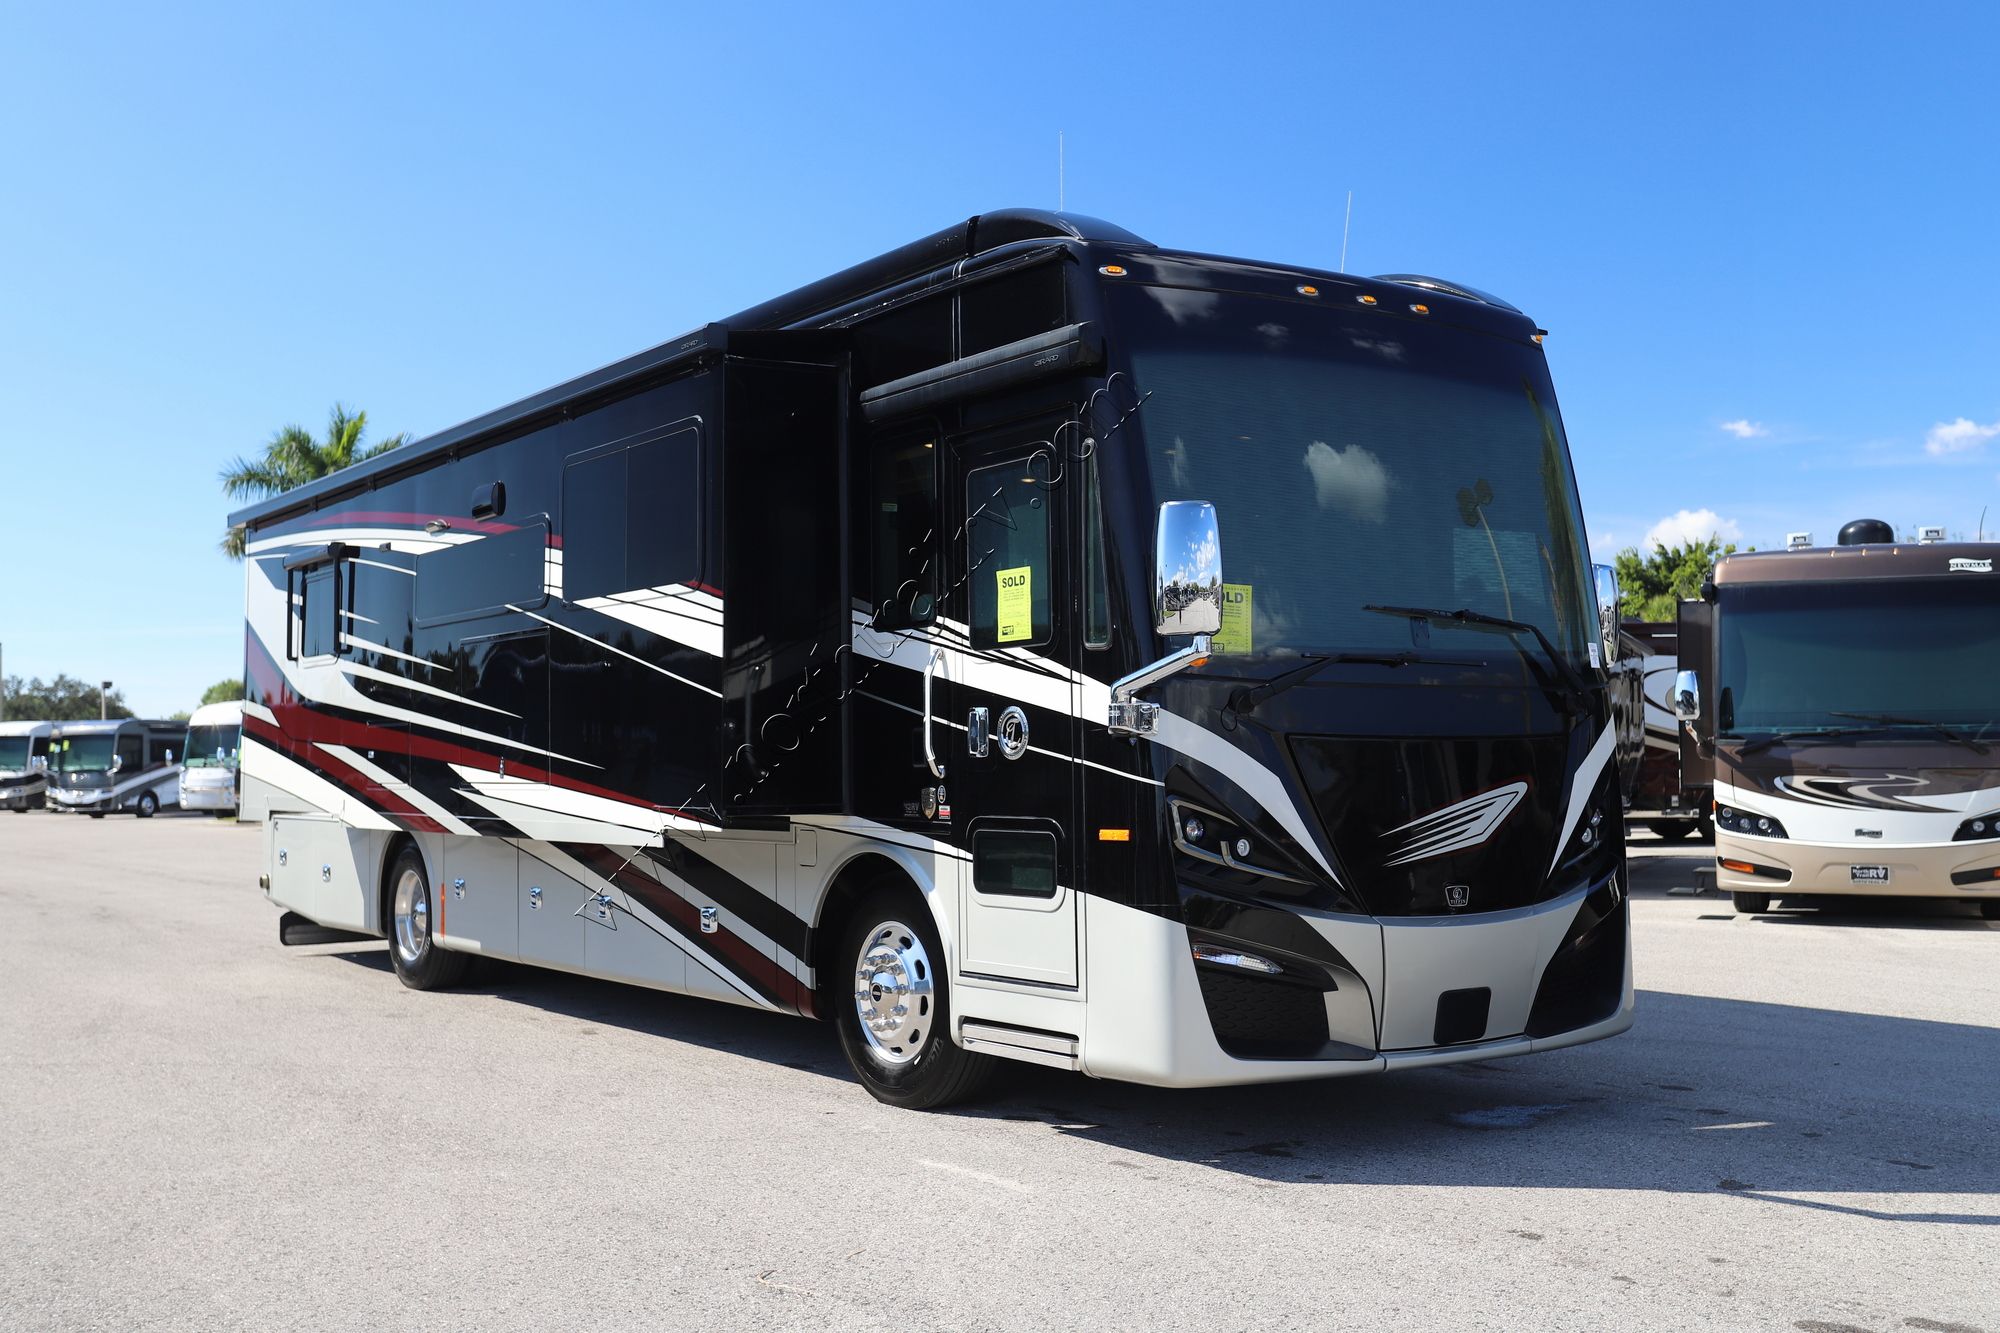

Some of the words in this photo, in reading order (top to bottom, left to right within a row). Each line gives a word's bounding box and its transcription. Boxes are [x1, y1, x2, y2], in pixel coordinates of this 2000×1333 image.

[1033, 354, 1059, 367] GIRARD
[1001, 575, 1025, 588] SOLD
[1869, 868, 1886, 878] RV
